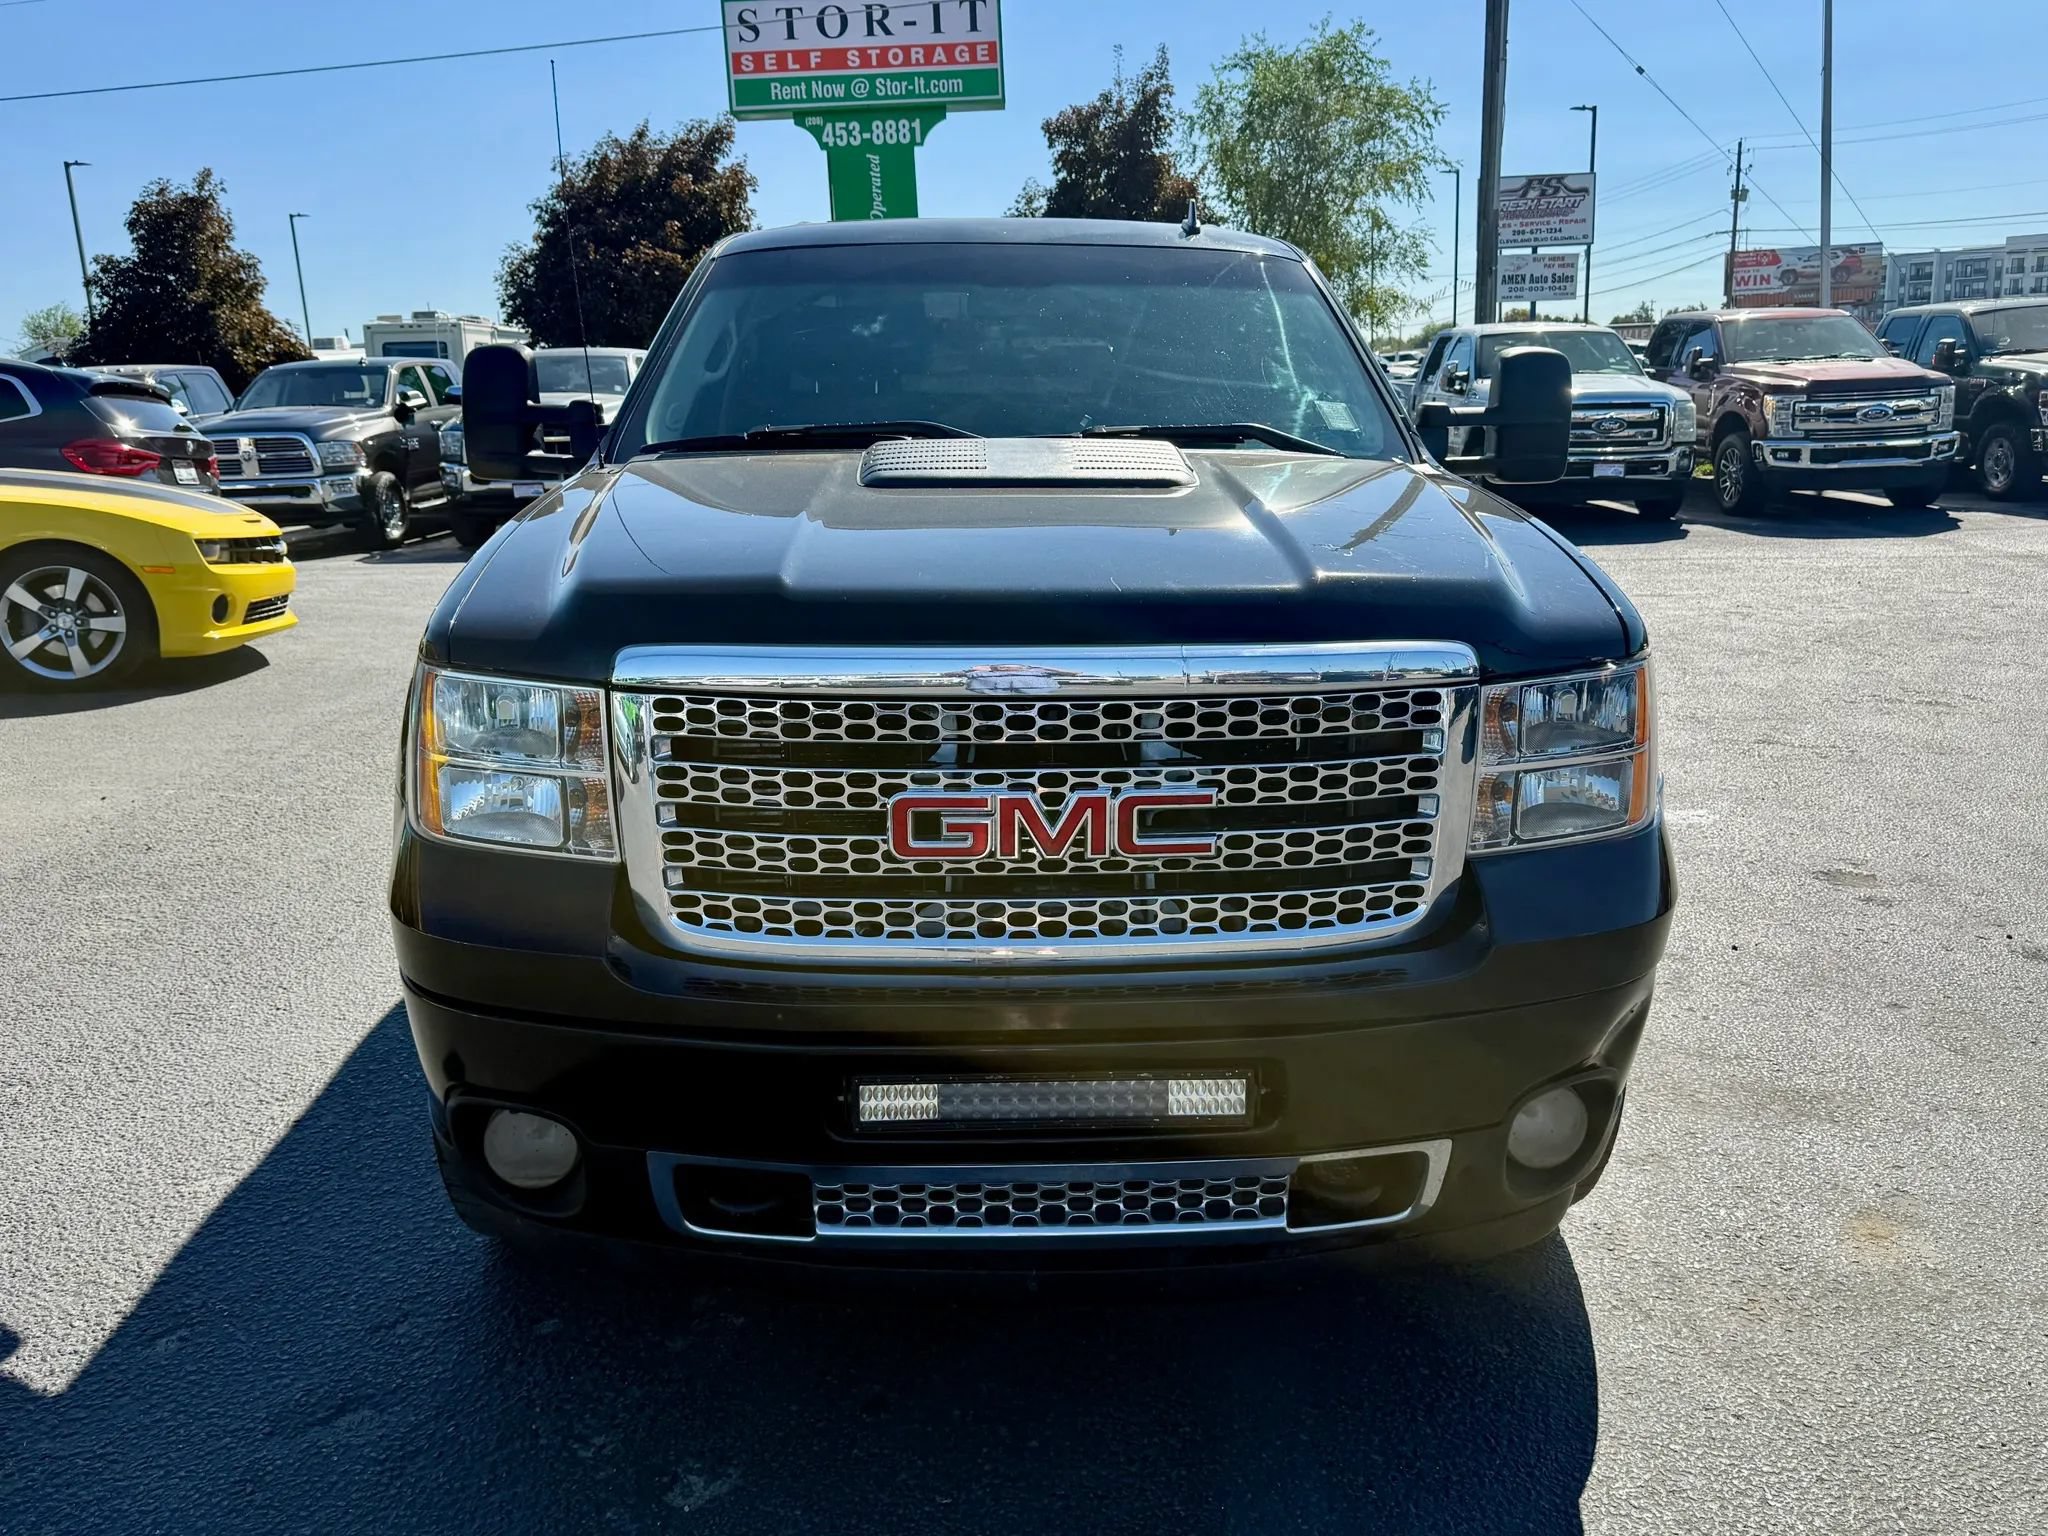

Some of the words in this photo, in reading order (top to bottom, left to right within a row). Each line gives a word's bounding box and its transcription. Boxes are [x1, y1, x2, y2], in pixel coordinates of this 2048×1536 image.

[737, 0, 987, 43] STOR-IT
[741, 51, 821, 73] SELF
[847, 44, 990, 67] STORAGE
[771, 81, 807, 101] Rent
[812, 80, 845, 98] Now
[851, 78, 870, 98] @
[876, 77, 963, 96] Stor-It.com
[822, 118, 922, 147] 453-8881
[1537, 195, 1586, 209] START
[1519, 218, 1551, 228] SERVICE
[1558, 218, 1587, 226] REPAIR
[1501, 273, 1527, 285] AMEN
[1528, 273, 1549, 284] Auto
[1551, 272, 1575, 284] Sales
[1735, 274, 1772, 287] WIN
[887, 786, 1218, 861] GMC
